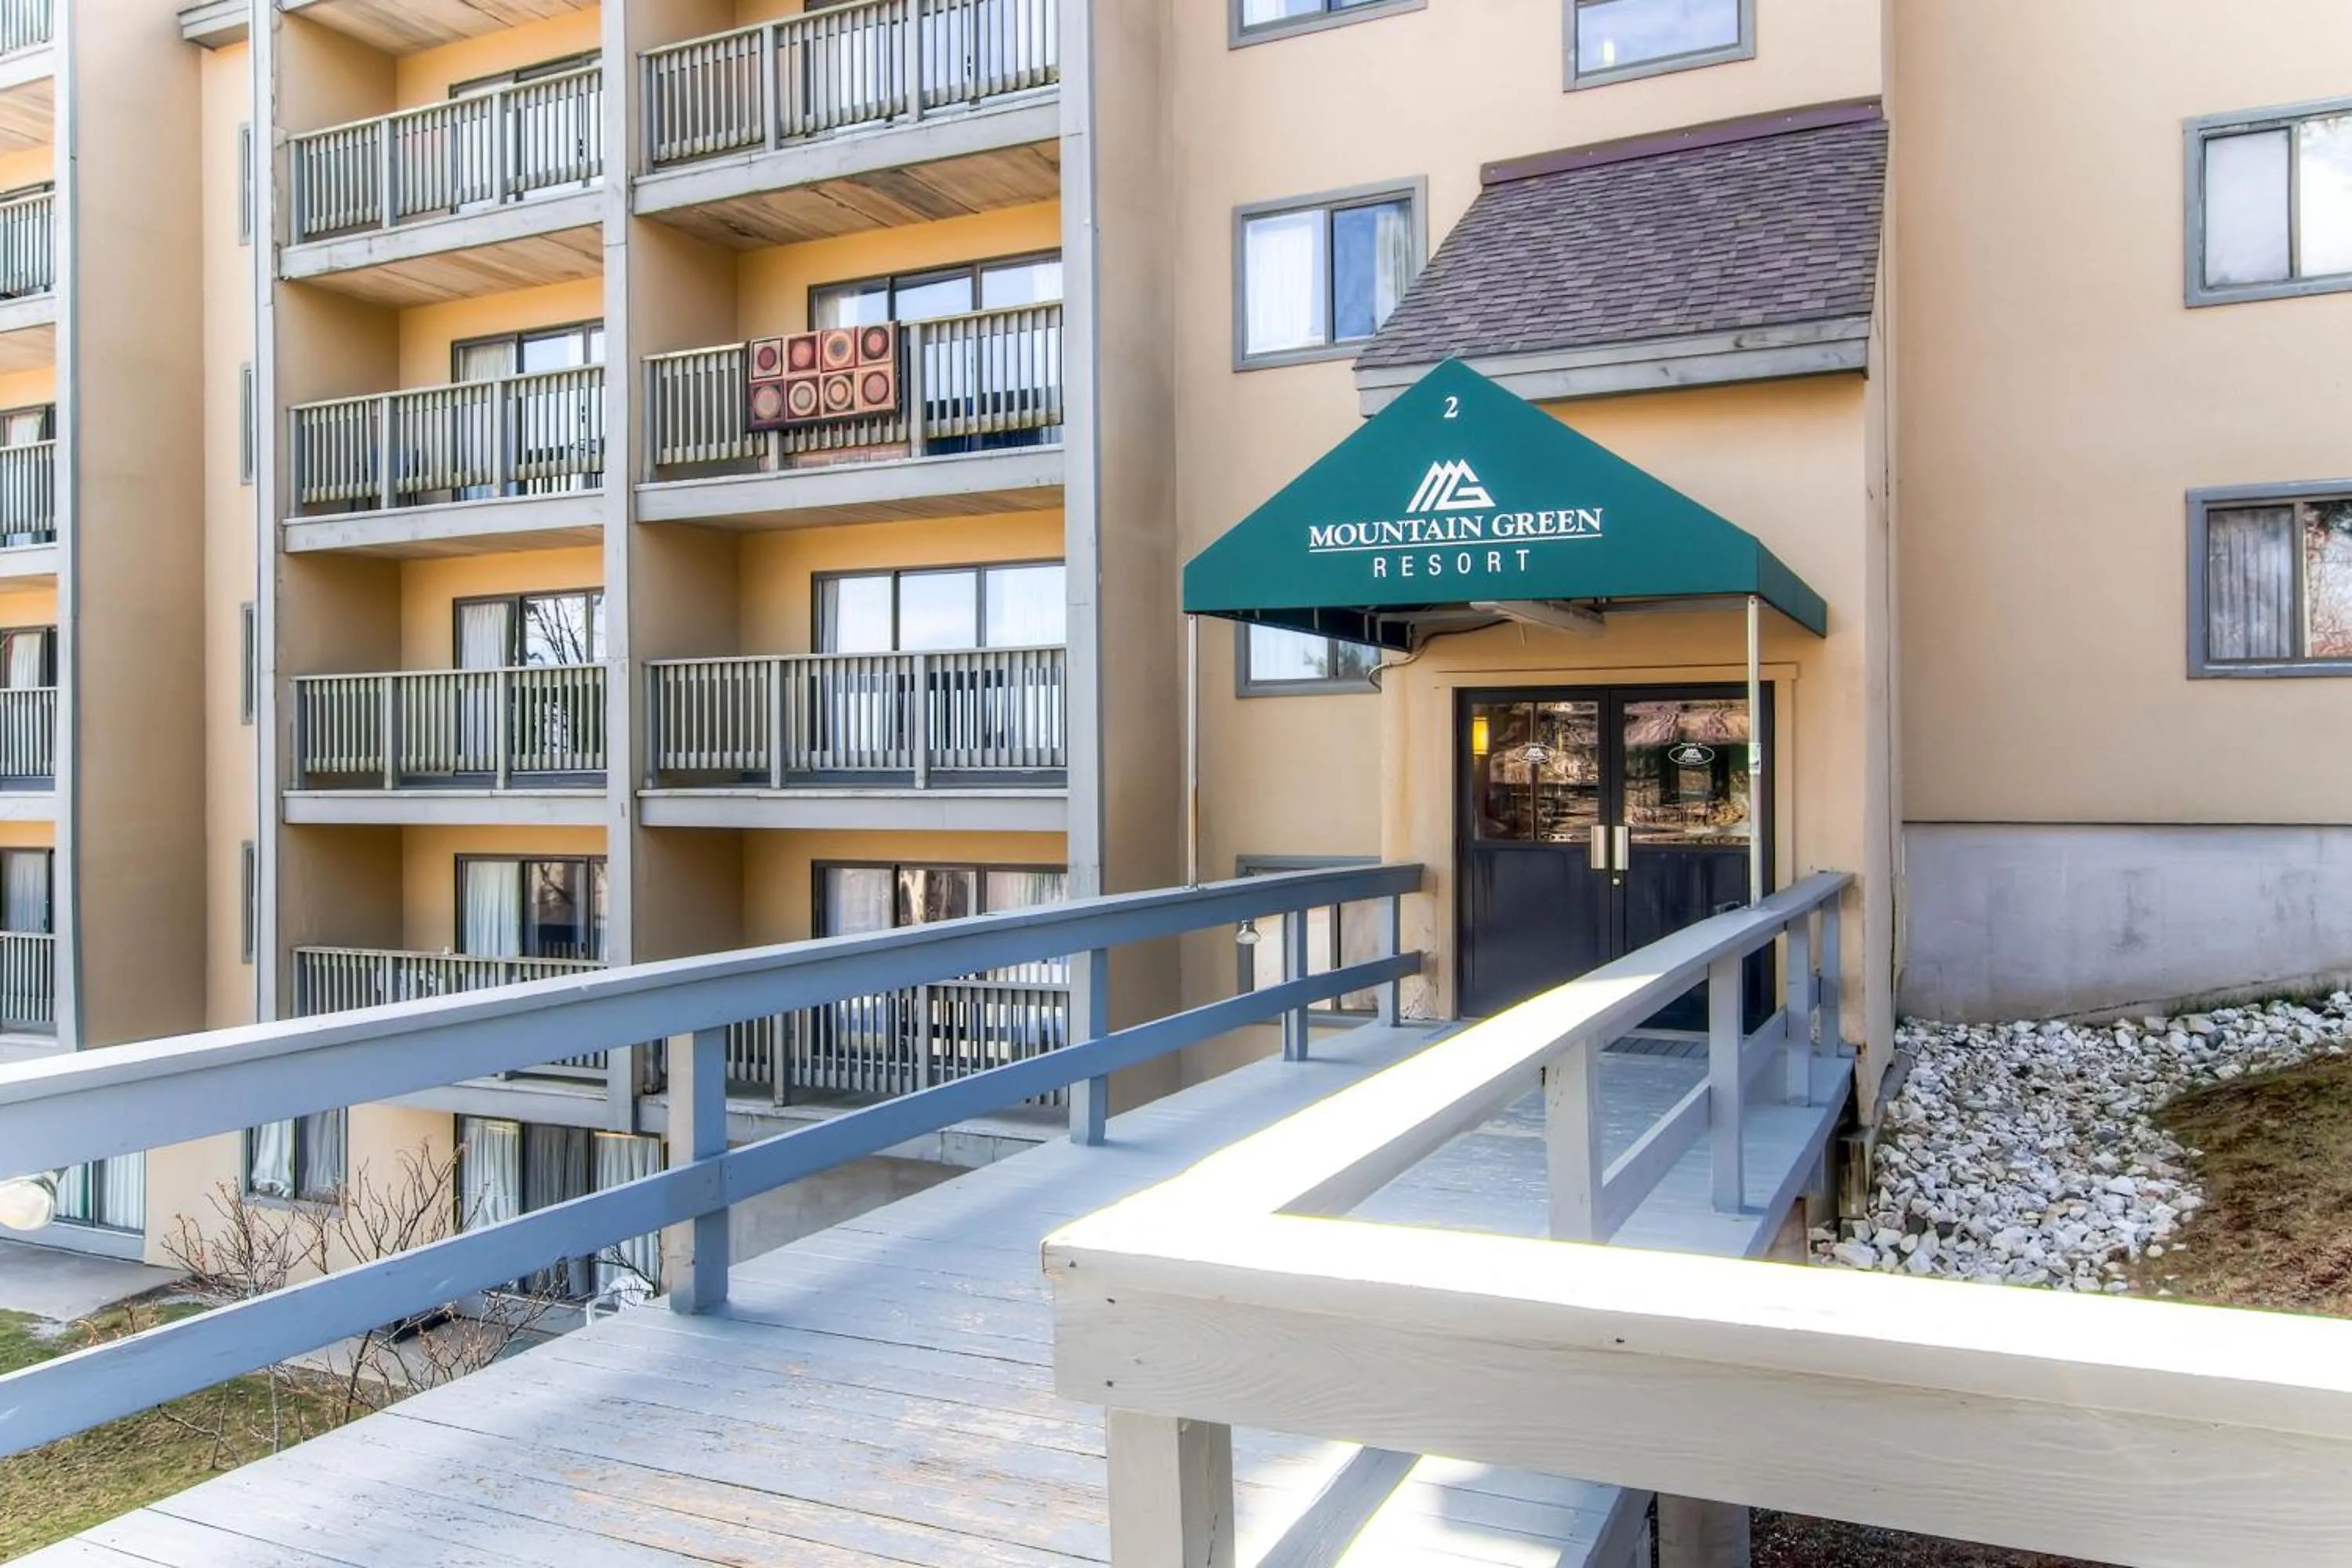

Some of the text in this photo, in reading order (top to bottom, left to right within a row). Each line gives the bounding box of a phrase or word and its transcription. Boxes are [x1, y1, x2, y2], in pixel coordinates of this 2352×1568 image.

[1443, 396, 1458, 419] 2
[1308, 507, 1602, 548] MOUNTAIN GREEN
[1374, 549, 1530, 578] RESORT
